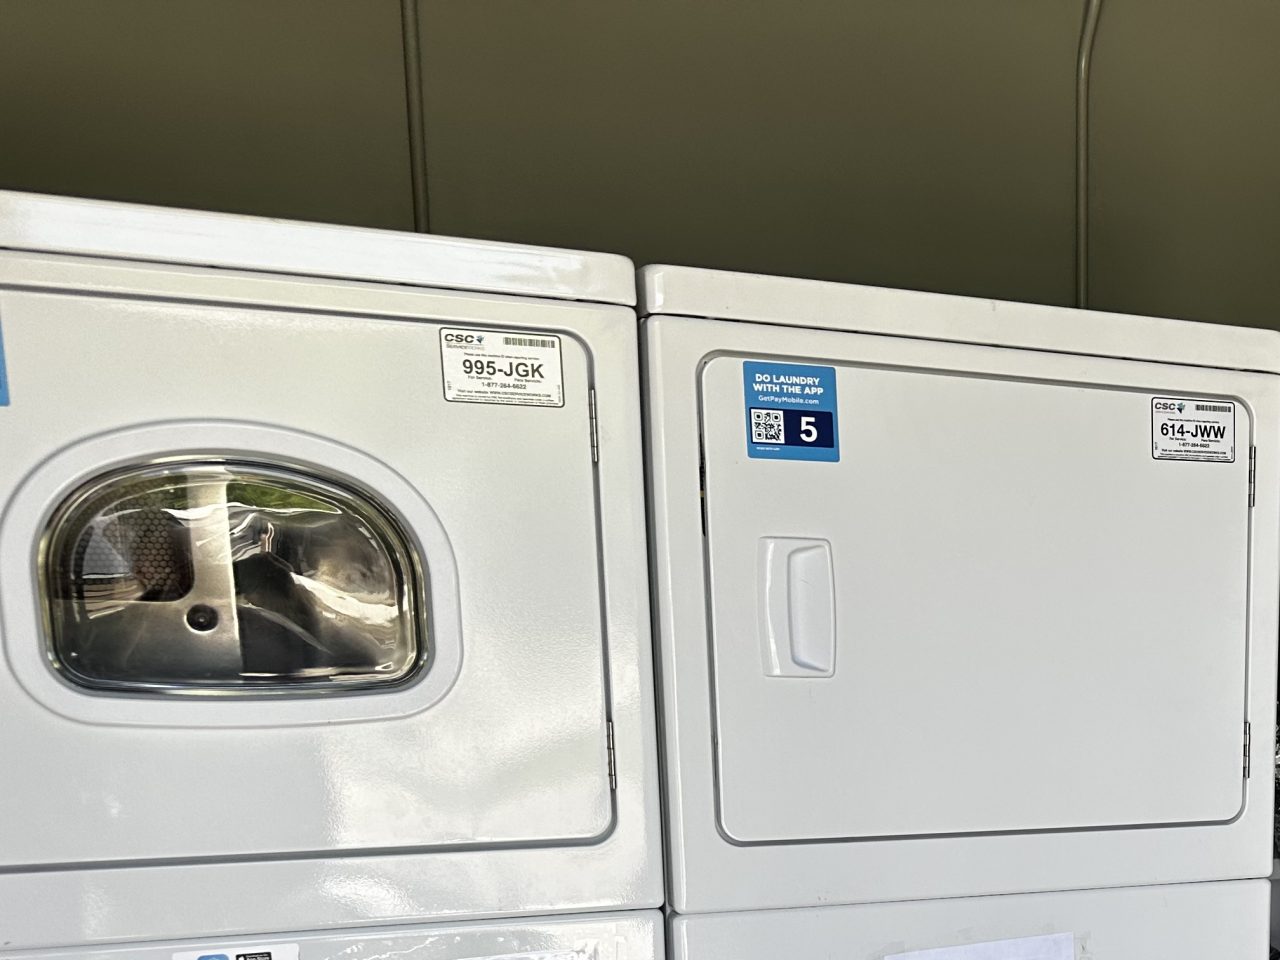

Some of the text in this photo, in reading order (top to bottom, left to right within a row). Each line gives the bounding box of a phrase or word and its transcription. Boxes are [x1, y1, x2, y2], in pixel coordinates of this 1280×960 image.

[444, 334, 475, 343] CSC
[462, 359, 544, 379] 995-JGK
[773, 375, 820, 385] LAUNDRY
[753, 384, 824, 395] WITH THE APP
[759, 395, 819, 404] GetPayMobile.com
[1155, 402, 1176, 410] CSC
[800, 417, 817, 442] 5
[1161, 423, 1225, 438] 614-JWW
